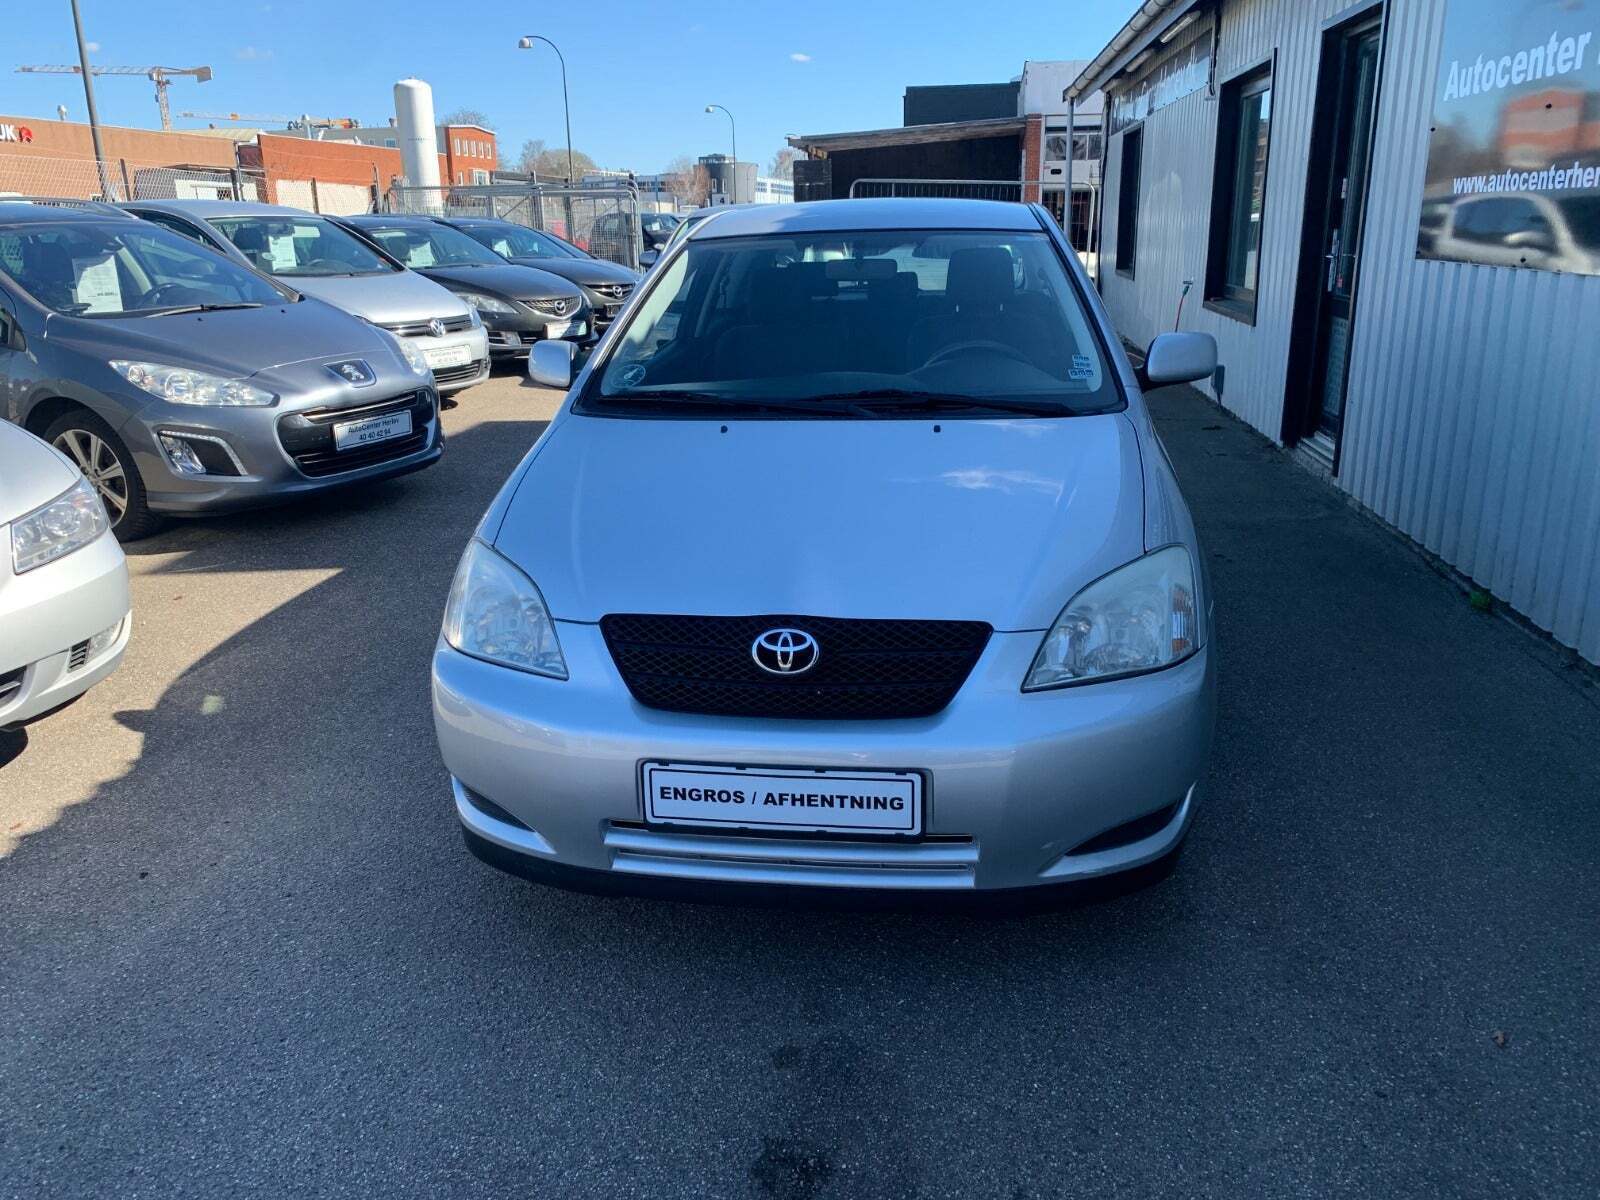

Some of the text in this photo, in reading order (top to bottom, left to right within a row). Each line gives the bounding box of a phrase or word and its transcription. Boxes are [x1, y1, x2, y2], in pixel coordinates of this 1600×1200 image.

[1444, 31, 1592, 100] Autocenter
[659, 786, 746, 804] ENGROS
[763, 791, 905, 811] AFHENTNING
